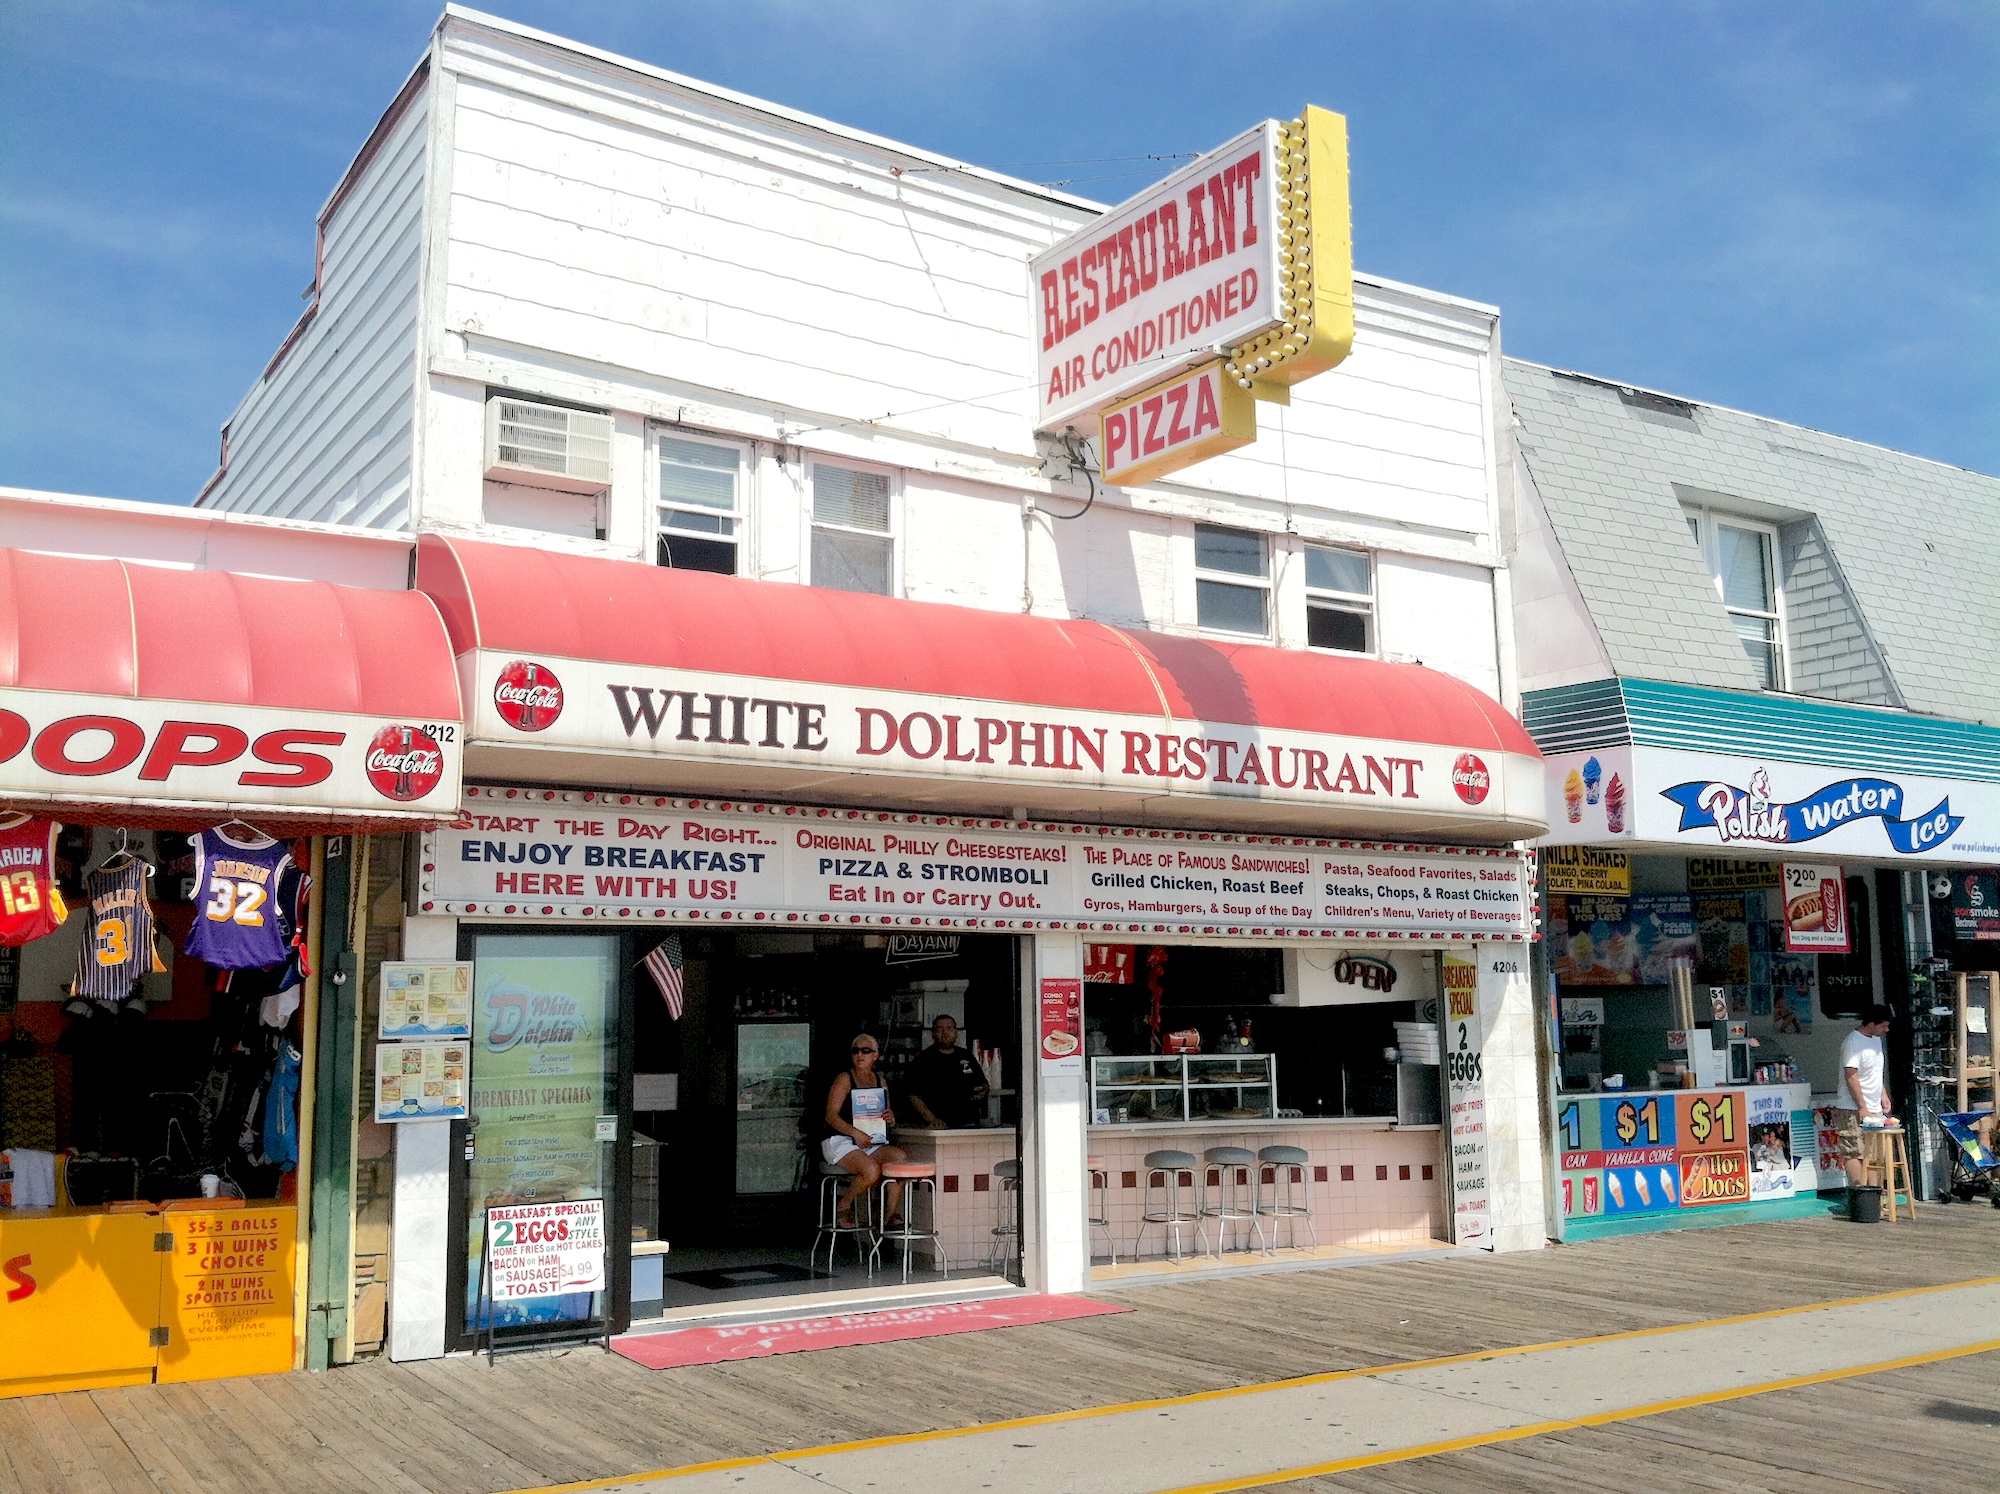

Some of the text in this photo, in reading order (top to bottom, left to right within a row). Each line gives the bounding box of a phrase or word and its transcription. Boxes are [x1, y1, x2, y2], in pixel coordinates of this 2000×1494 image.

[1041, 151, 1260, 352] RESTAURANT
[1047, 268, 1258, 404] AIR CONDITIONED
[1106, 374, 1220, 470] PIZZA
[494, 682, 560, 711] Coca-Cola
[421, 724, 454, 743] 4212
[607, 684, 1423, 799] WHITE DOLPHIN RESTAURANT
[0, 707, 346, 787] OPS
[367, 749, 440, 774] Coca-Cola
[450, 810, 539, 833] START
[555, 819, 604, 837] THE
[618, 819, 670, 840] DAY
[1697, 781, 1789, 842] Polish
[1910, 811, 1949, 849] Ice
[462, 840, 765, 872] ENJOY BREAKFAST
[796, 830, 1067, 862] ORIGINAL PHILLY CHEESESTEAKS!
[1083, 846, 1310, 874] THE PLACE OF FAMOUS SANDWICHES!
[819, 858, 1048, 885] PIZZA & STROMBOLI
[1324, 863, 1517, 882] Pasta, Seafood Favorites, Salads
[1550, 867, 1608, 878] MANGO, CHERRY
[0, 870, 40, 915] 13
[495, 872, 736, 900] HERE WITH US!
[1091, 872, 1304, 895] Grilled Chicken, Roast Beef
[1325, 884, 1519, 902] Steaks, Chops, & Roast Chicken
[1578, 879, 1594, 889] PINA
[206, 877, 268, 927] 32
[829, 884, 1041, 911] Eat In or Carry Out.
[1084, 898, 1313, 919] Gyros, Hamburgers, & Soup of the Day
[1325, 906, 1522, 922] Children's Menu, Variety of Beverages
[1335, 957, 1396, 993] OPEN
[1444, 965, 1476, 988] BREAKFAST
[1492, 961, 1517, 973] 4206
[1450, 991, 1474, 1015] SPECIAL
[1458, 1022, 1467, 1051] 2
[1448, 1052, 1482, 1081] EGGS
[474, 1086, 592, 1108] BREAKFAST SPECIALS
[1753, 1097, 1783, 1111] THIS IS
[1616, 1097, 1660, 1146] $1
[1690, 1095, 1735, 1144] $1
[1763, 1111, 1788, 1124] BEST!
[1453, 1123, 1483, 1136] HOT CAKES
[1454, 1143, 1476, 1156] BACON
[1605, 1148, 1673, 1166] VANILLA CONE
[1459, 1161, 1473, 1173] HAM
[1566, 1155, 1588, 1168] CAN
[1710, 1155, 1740, 1176] HOT
[1457, 1178, 1485, 1191] SAUSAGE
[1701, 1177, 1745, 1197] DOGS
[490, 1207, 552, 1221] BREAKFAST
[555, 1203, 600, 1216] SPECIAL!
[1469, 1200, 1486, 1211] TOAST
[231, 1218, 278, 1231] BALLS
[494, 1215, 597, 1247] 2 EGGS ANY
[568, 1228, 599, 1240] STYLE
[187, 1238, 278, 1255] 3 IN WINS
[493, 1247, 518, 1257] HOME
[520, 1244, 545, 1254] FRIES
[557, 1241, 573, 1252] HOT
[575, 1239, 603, 1250] CAKES
[200, 1254, 264, 1269] CHOICE
[494, 1257, 525, 1270] BACON
[538, 1254, 559, 1267] HAM
[198, 1277, 264, 1291] 2 IN WINS
[495, 1267, 559, 1282] OR SAUSAGE
[186, 1289, 274, 1305] SPORTS BALL
[506, 1281, 559, 1296] TOAST
[197, 1309, 258, 1319] KIDS WIN
[216, 1317, 251, 1325] PRIZE
[717, 1302, 984, 1338] White Dolphin
[237, 1322, 266, 1331] IME
